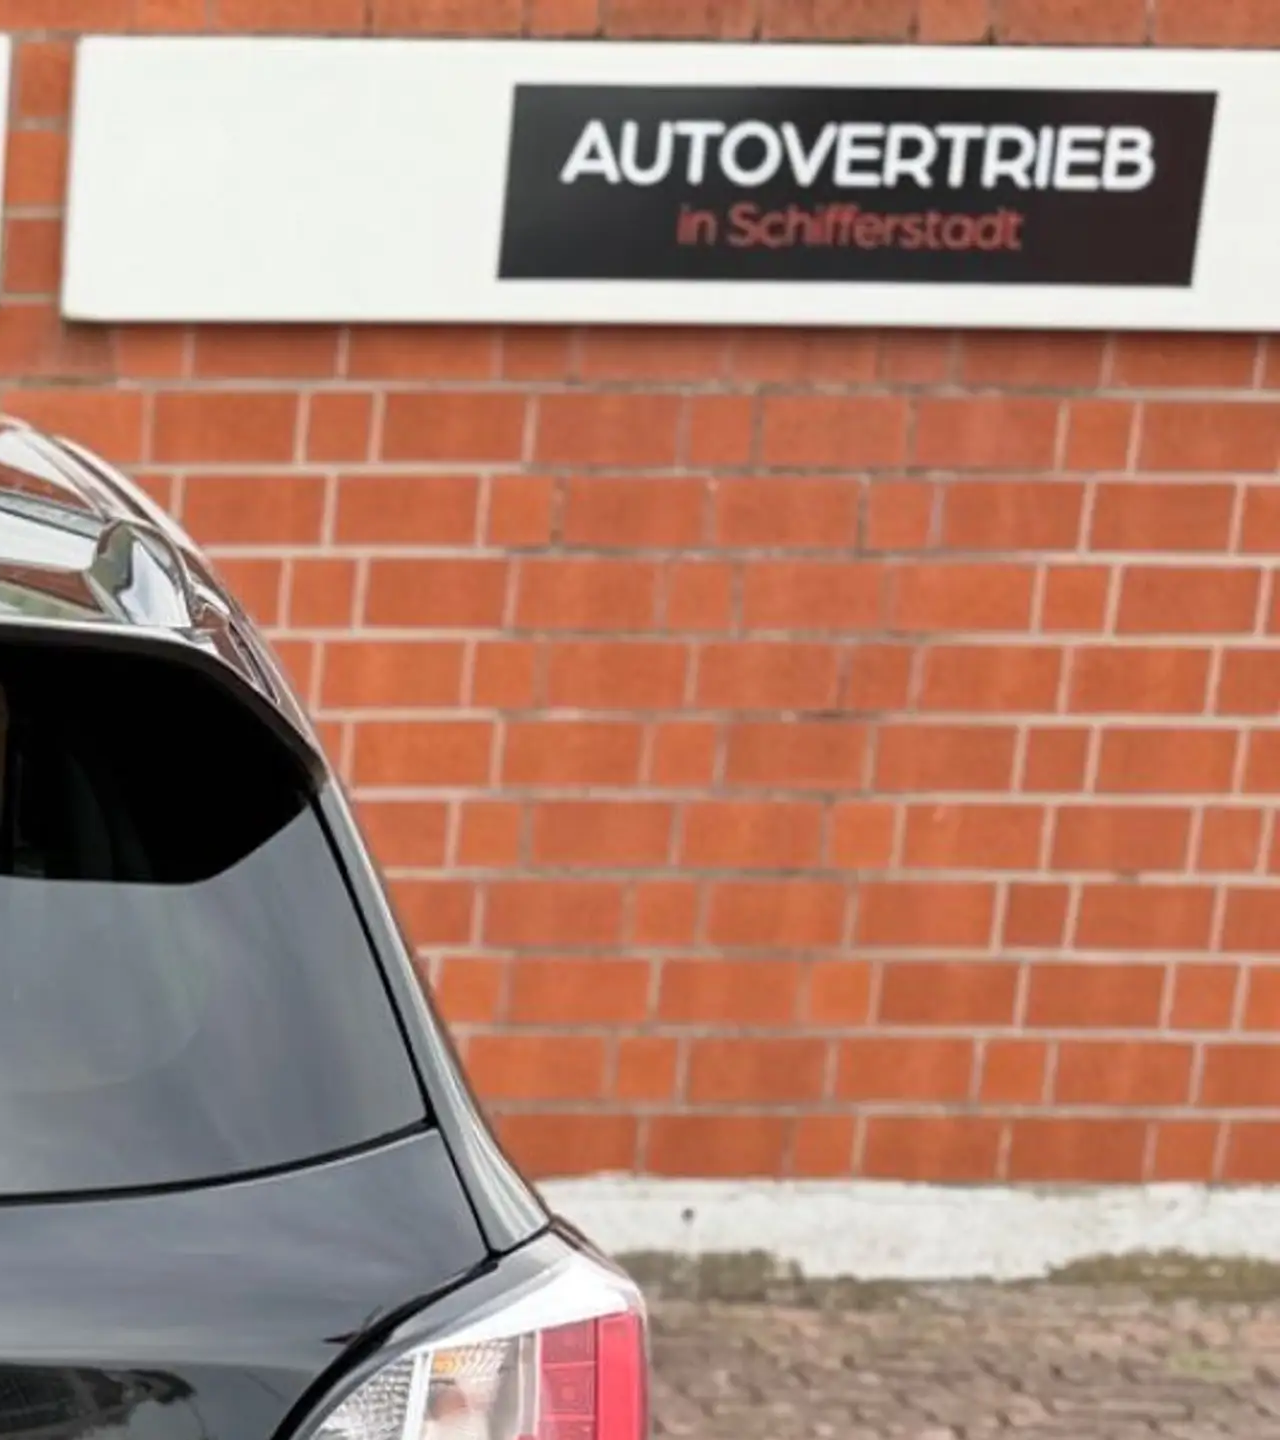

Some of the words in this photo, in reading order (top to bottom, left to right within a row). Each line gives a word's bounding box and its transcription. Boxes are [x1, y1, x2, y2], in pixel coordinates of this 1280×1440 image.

[560, 119, 1156, 191] AUTOVERTRIEB
[676, 203, 718, 246] in
[728, 203, 1024, 251] Schifferstadt
